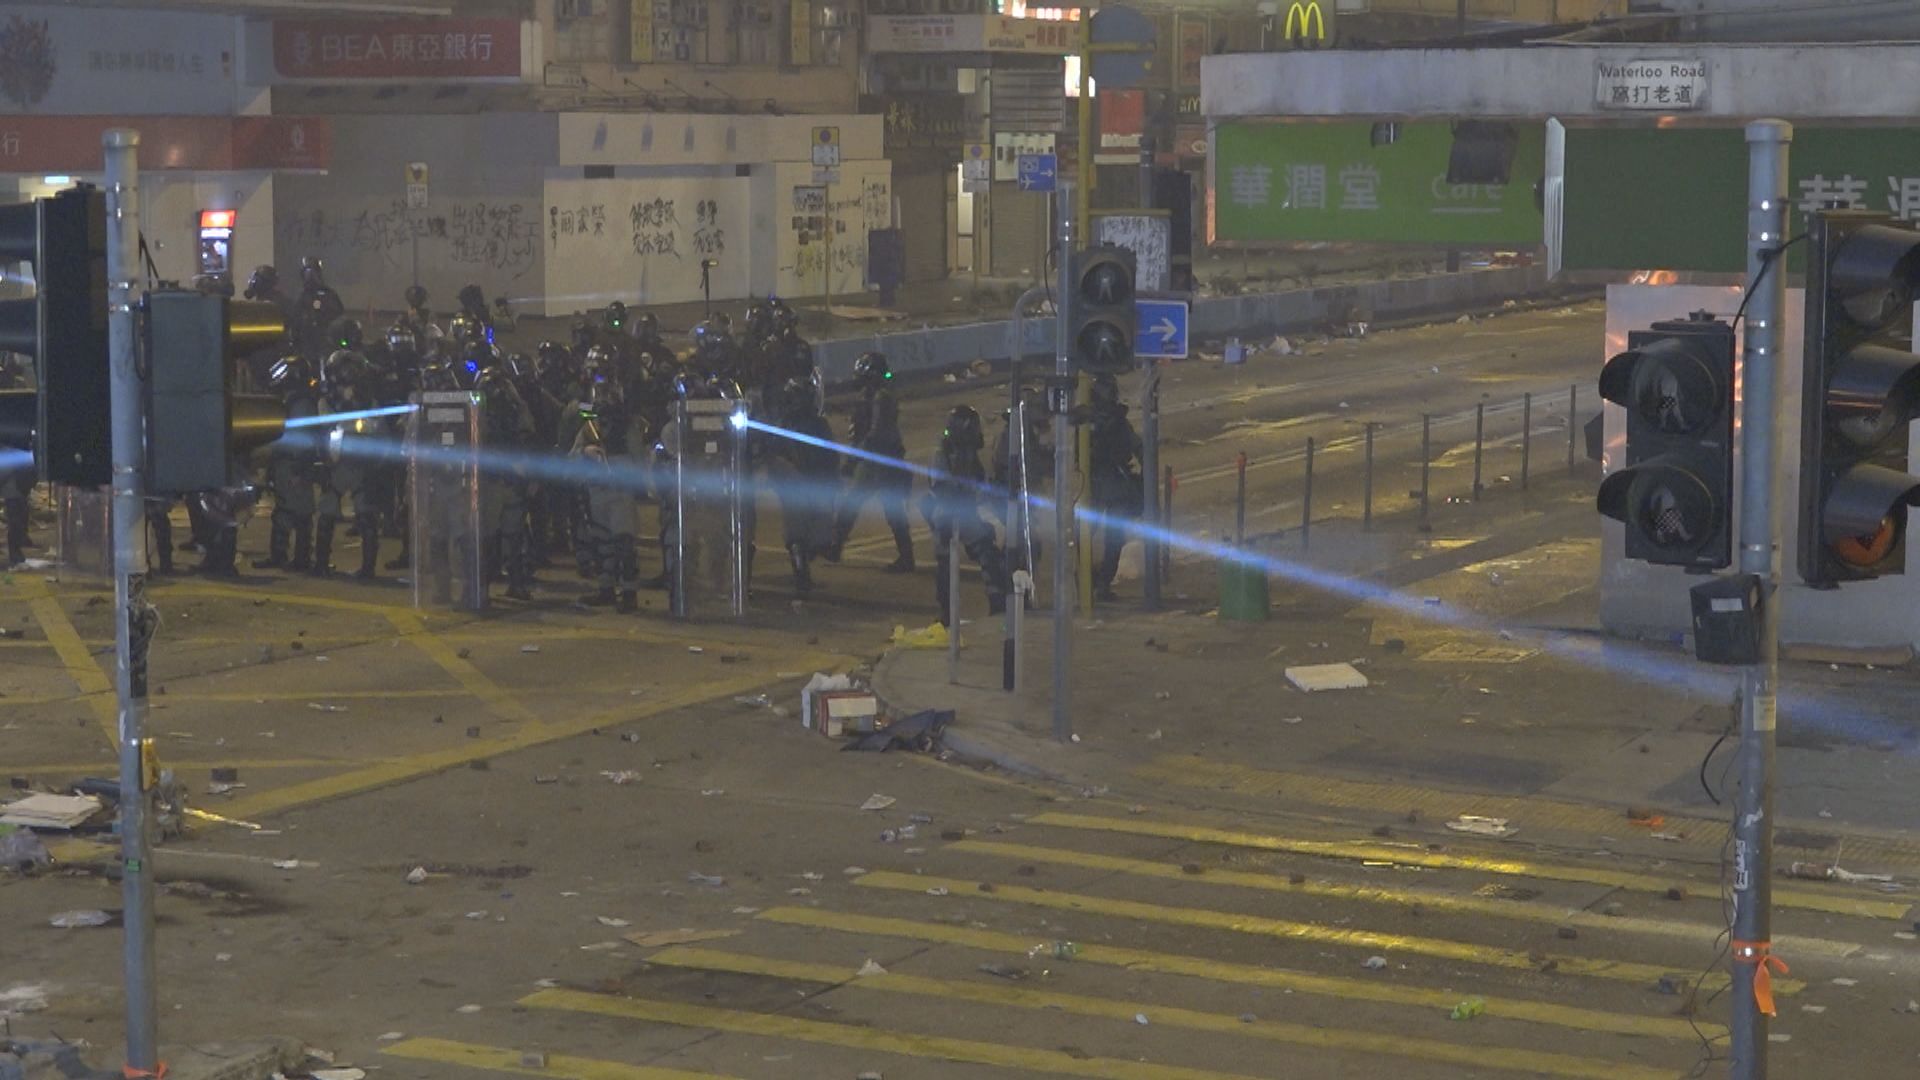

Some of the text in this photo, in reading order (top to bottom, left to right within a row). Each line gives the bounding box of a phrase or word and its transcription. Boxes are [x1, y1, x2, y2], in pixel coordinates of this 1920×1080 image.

[321, 32, 493, 62] BEA 東亞銀行
[1599, 64, 1706, 78] Waterloo Road
[1611, 84, 1691, 104] 窩打老道
[1231, 163, 1381, 209] 華潤堂
